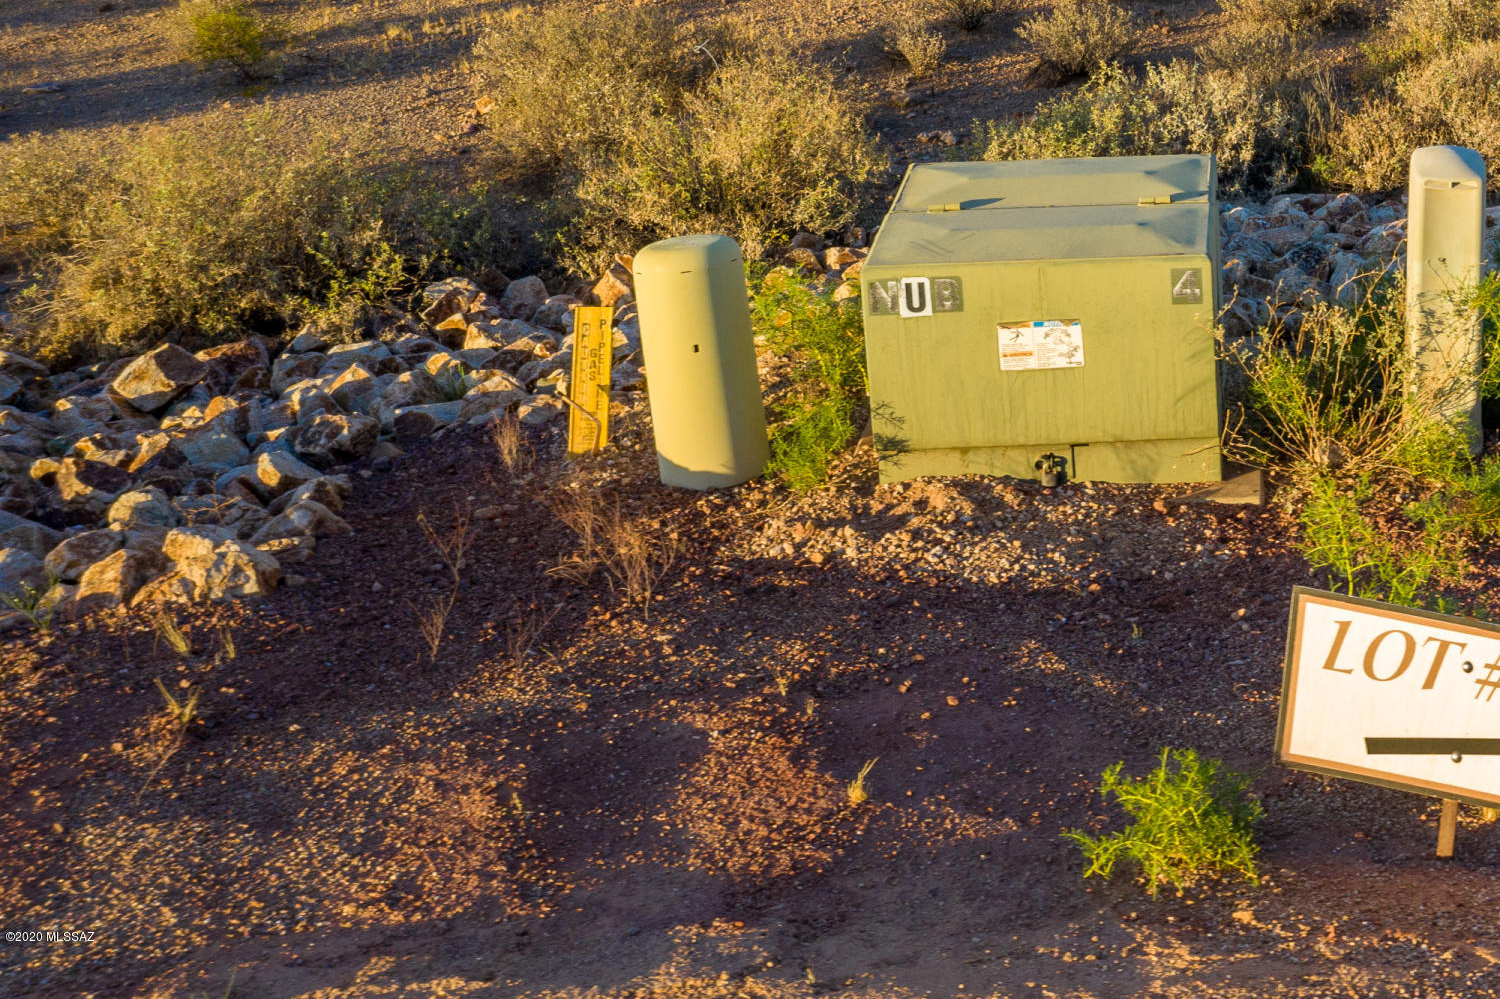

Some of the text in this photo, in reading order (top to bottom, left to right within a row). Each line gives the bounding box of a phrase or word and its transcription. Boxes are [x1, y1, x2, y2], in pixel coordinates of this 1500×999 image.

[1173, 269, 1202, 303] 4
[589, 348, 598, 382] GAS
[1322, 620, 1467, 691] LOT
